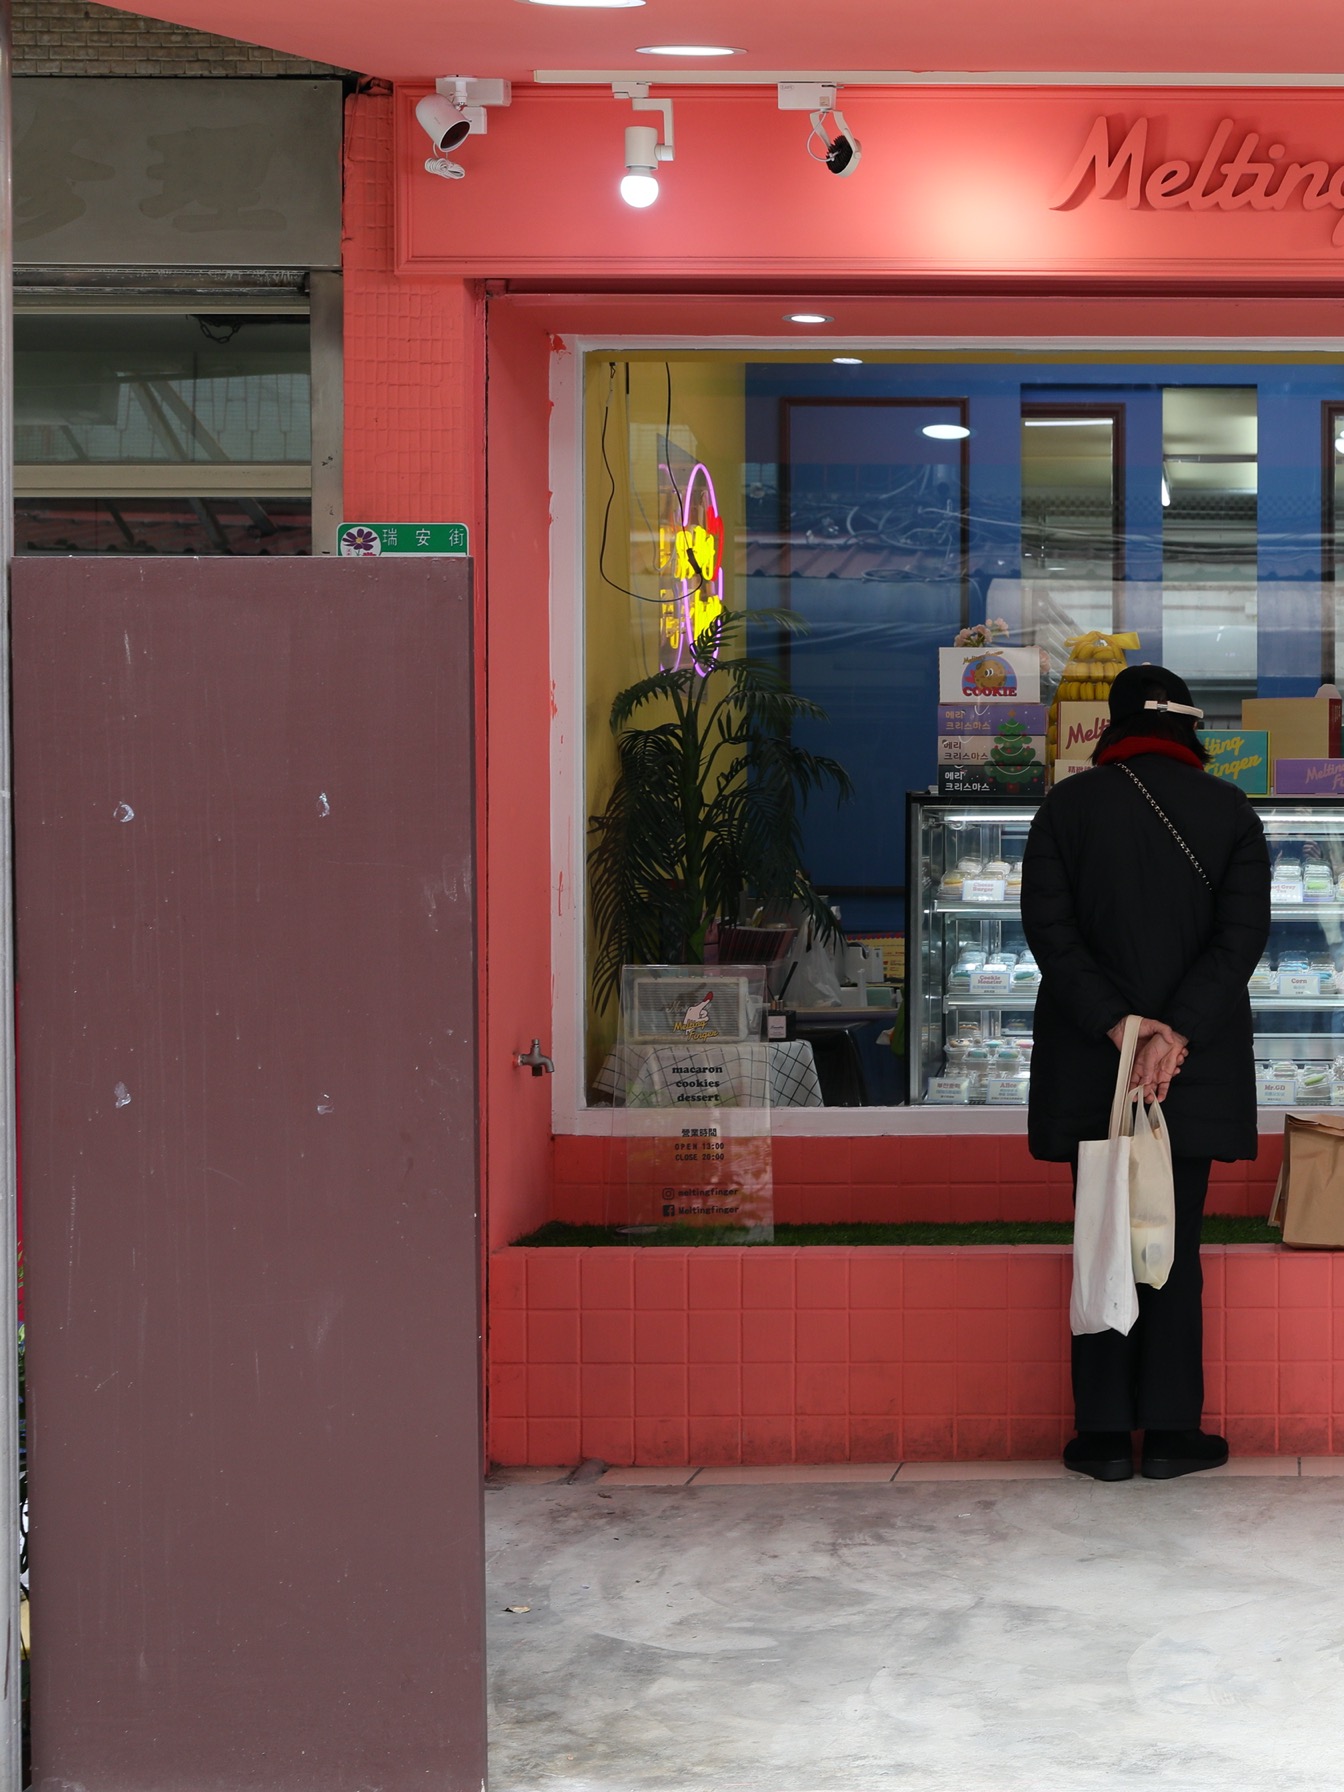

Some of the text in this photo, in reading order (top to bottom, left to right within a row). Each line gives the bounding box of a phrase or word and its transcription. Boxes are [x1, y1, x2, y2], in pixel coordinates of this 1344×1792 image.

[382, 527, 464, 546] 瑞安街
[962, 686, 1017, 697] COOKIE
[945, 783, 990, 791] 크리스마스
[673, 1021, 707, 1033] Melting
[687, 1029, 720, 1042] Finger
[672, 1066, 723, 1074] macaron
[676, 1079, 720, 1087] cookies
[677, 1094, 720, 1102] dessert
[681, 1128, 717, 1137] 營業時間
[678, 1188, 738, 1197] meltingfinger
[678, 1206, 739, 1215] Meltingfinger
